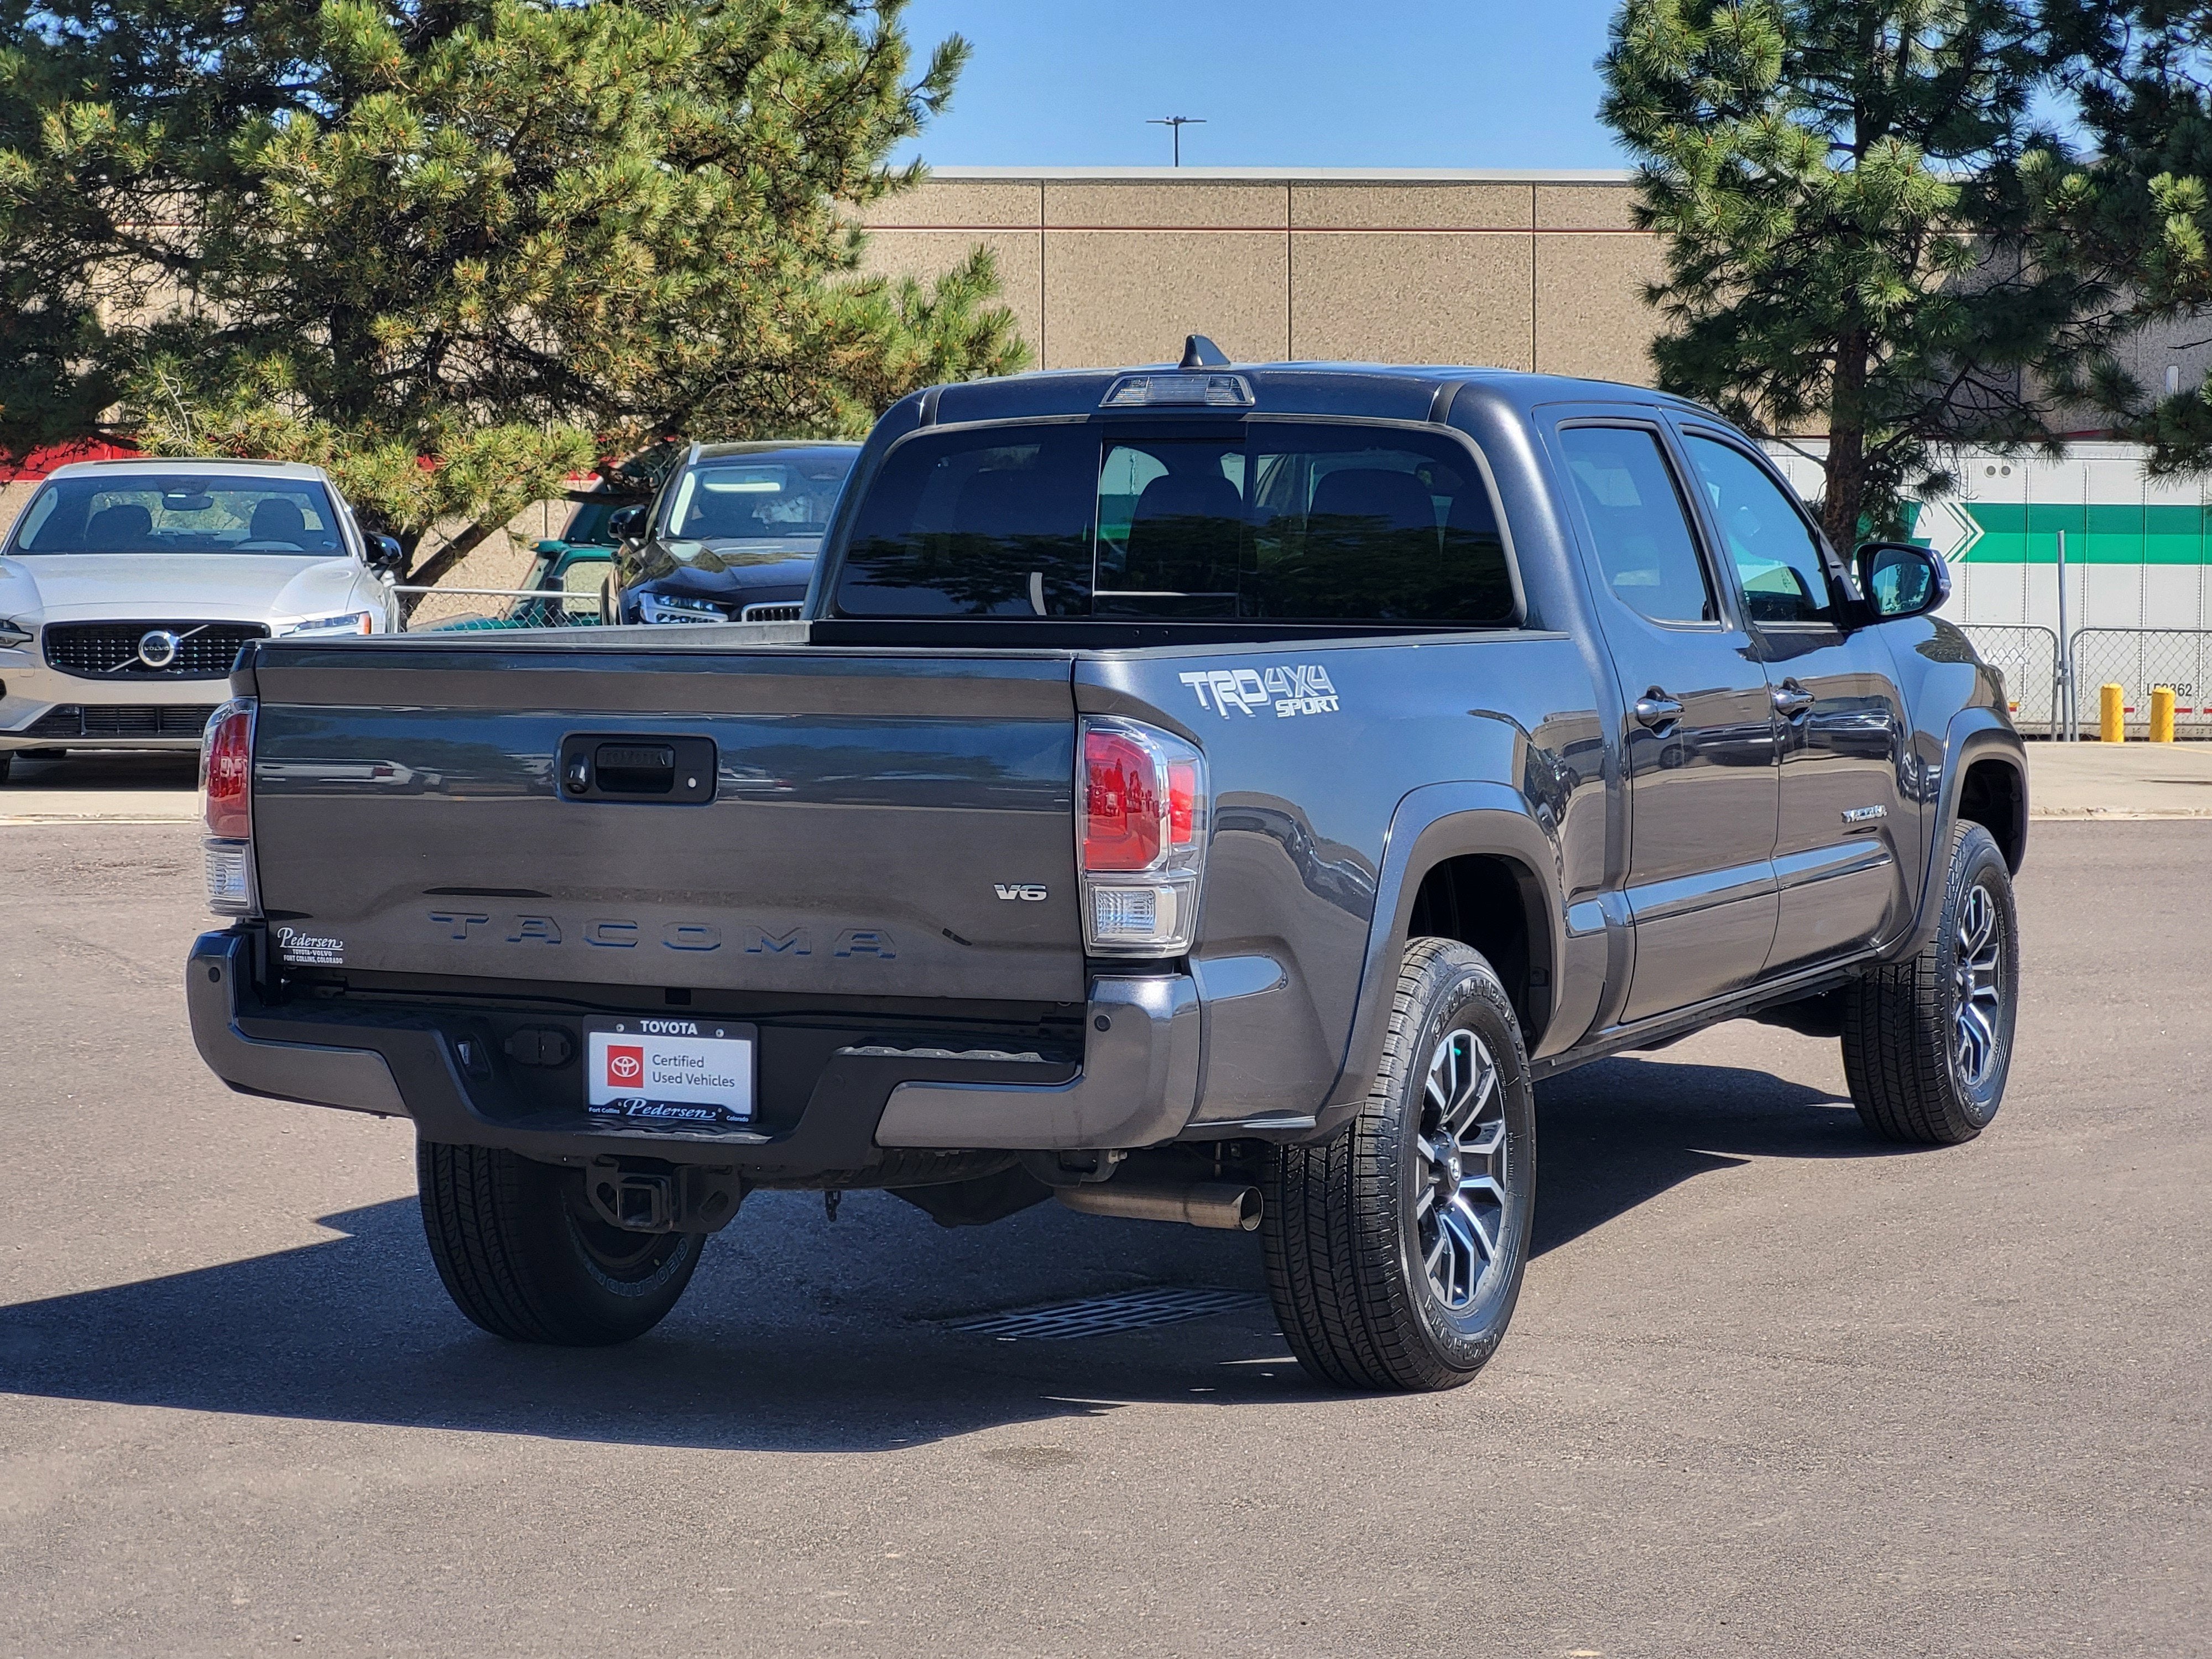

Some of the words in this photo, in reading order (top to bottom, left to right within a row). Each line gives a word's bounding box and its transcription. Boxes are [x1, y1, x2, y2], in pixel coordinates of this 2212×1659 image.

[1178, 669, 1271, 719] TRD
[1275, 695, 1339, 718] SPORT
[994, 884, 1047, 901] V6
[277, 927, 343, 948] Pedersen
[429, 911, 896, 959] TACOMA
[640, 1020, 698, 1035] TOYOTA
[652, 1054, 705, 1068] Certified
[652, 1071, 683, 1084] Used
[685, 1073, 735, 1087] Vehicles
[623, 1098, 716, 1119] Pedersen
